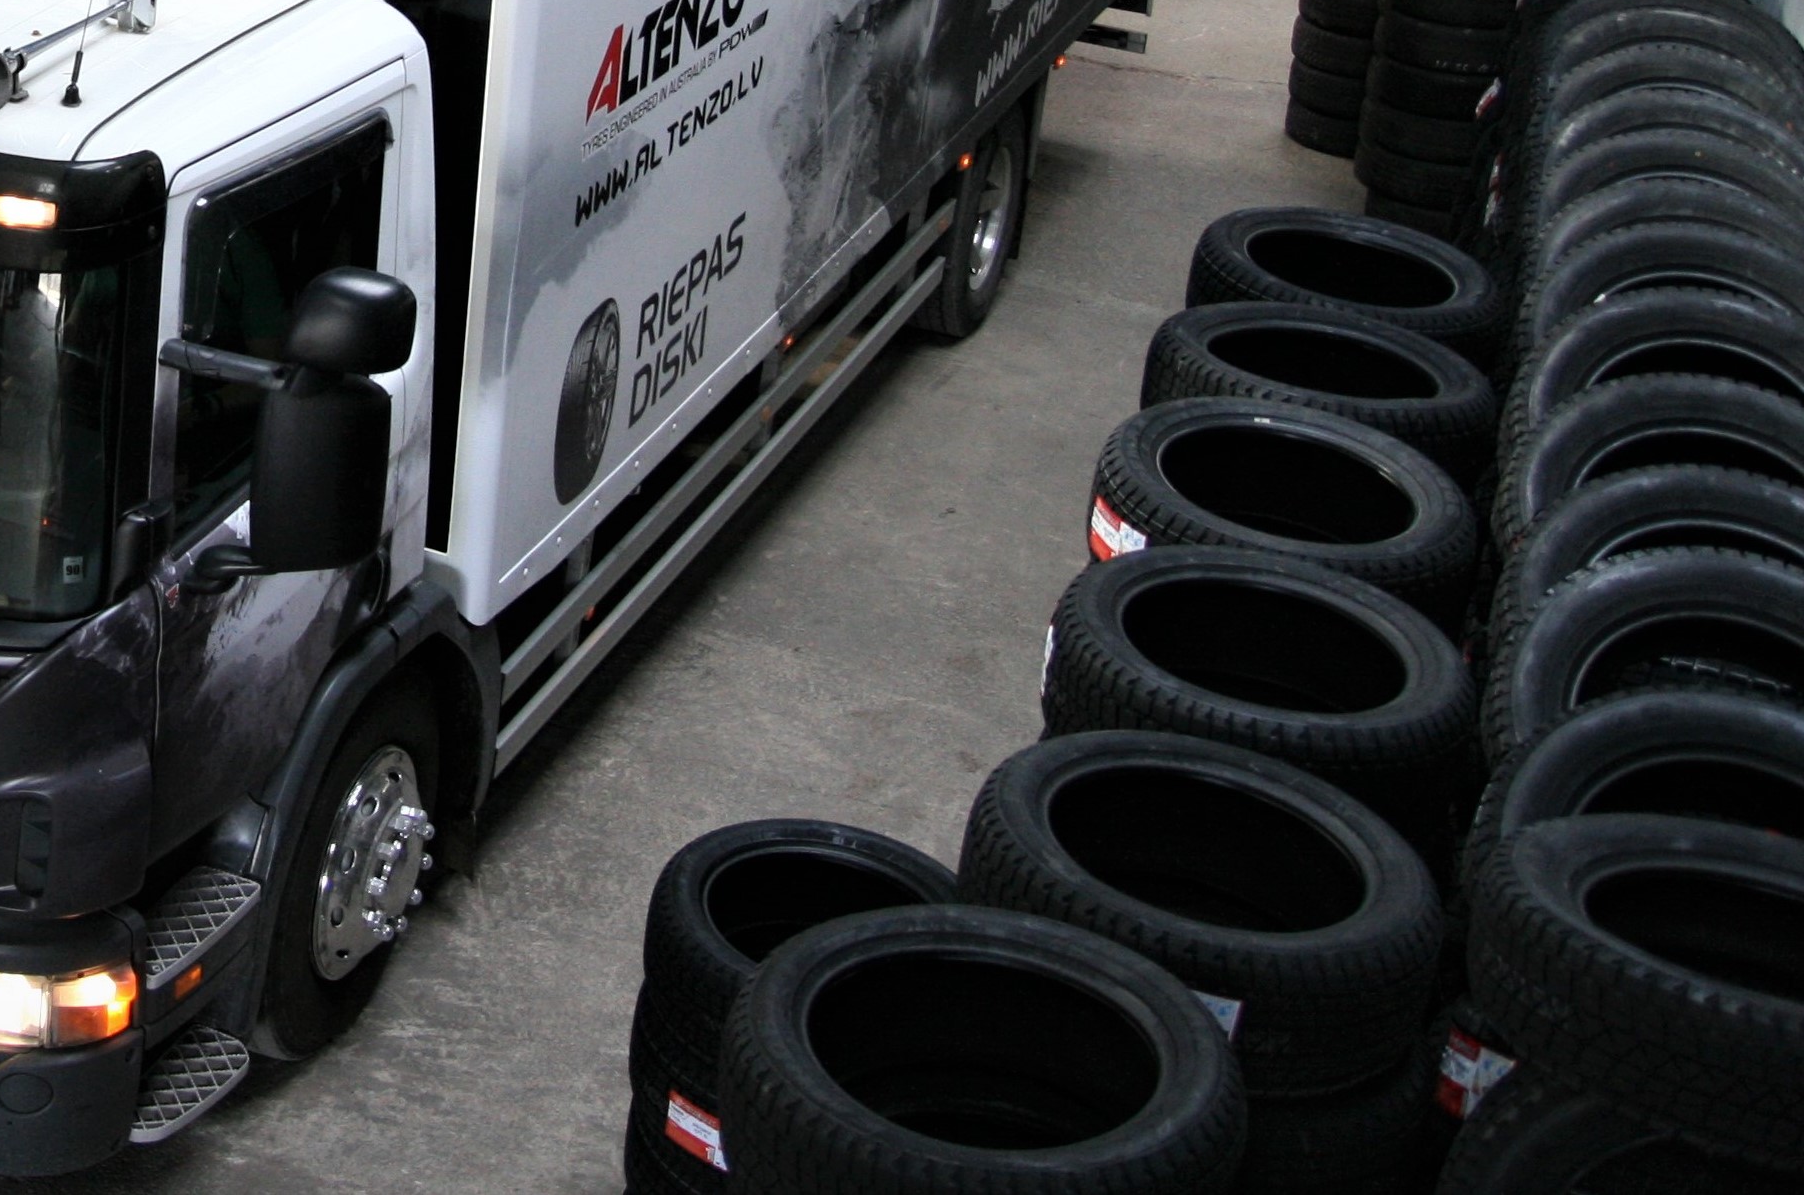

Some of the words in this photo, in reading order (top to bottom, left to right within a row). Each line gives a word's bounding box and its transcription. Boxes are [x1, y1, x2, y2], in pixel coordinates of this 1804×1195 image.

[581, 128, 609, 159] TYRES
[609, 93, 659, 140] ENGINEERED
[659, 87, 667, 103] IN
[636, 211, 747, 360] RIEPAS
[628, 305, 709, 430] DISKI
